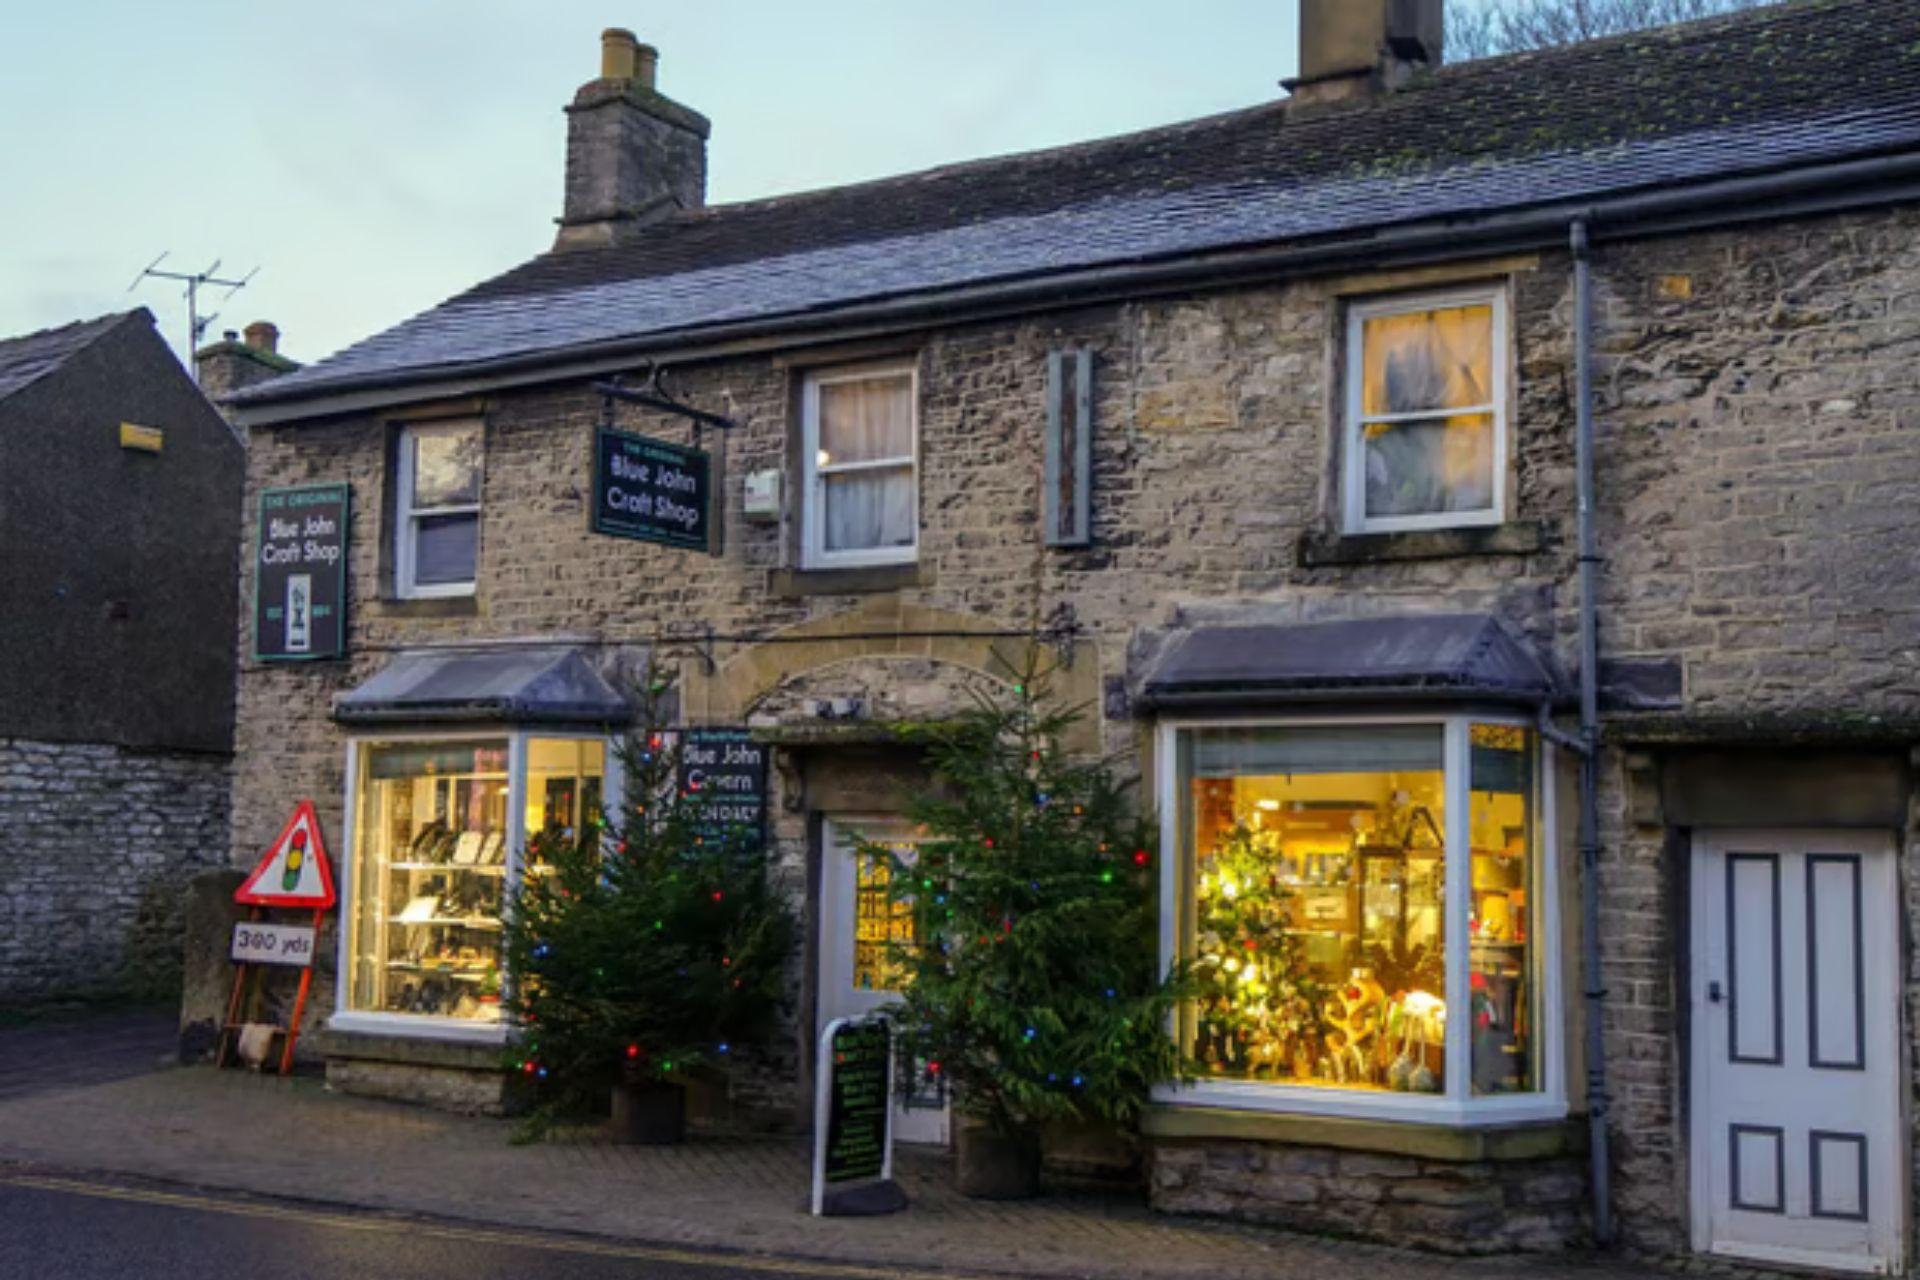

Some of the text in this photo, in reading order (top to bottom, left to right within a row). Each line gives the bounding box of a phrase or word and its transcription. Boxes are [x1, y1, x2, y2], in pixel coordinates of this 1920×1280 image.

[611, 453, 696, 493] Blue John
[607, 486, 699, 531] Craft Shop
[269, 514, 336, 540] Blue John
[262, 540, 340, 566] Craft Shop
[683, 743, 761, 765] Blue John
[282, 936, 310, 956] yds
